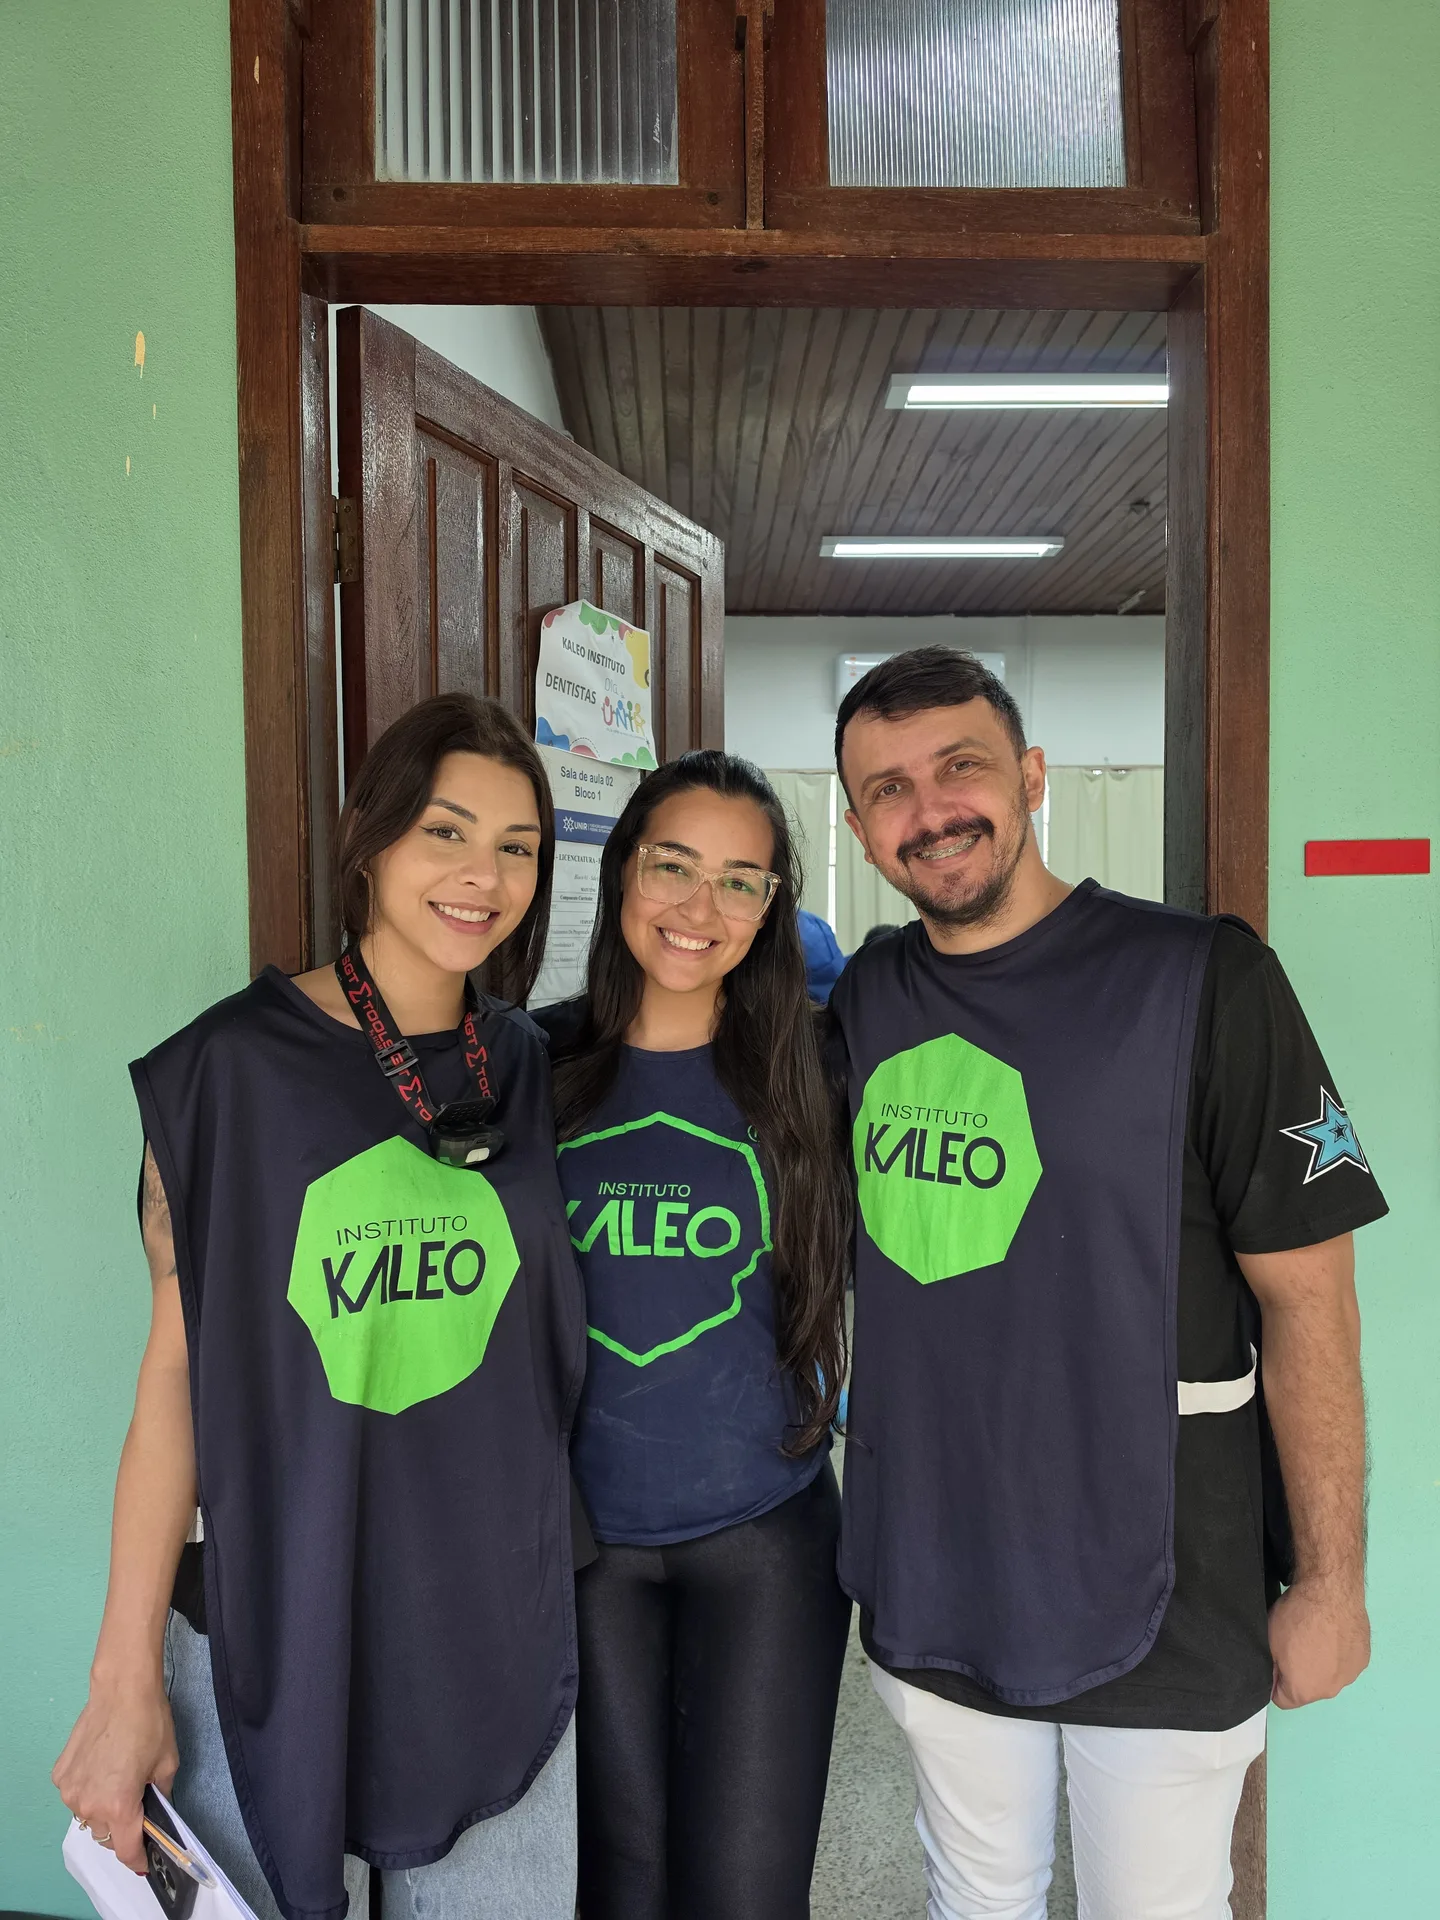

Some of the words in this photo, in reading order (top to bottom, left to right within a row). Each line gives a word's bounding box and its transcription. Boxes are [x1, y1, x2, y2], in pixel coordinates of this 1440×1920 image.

[562, 637, 586, 659] KALEO
[587, 649, 626, 676] INSTITUTO
[545, 672, 597, 705] DENTISTAS
[560, 766, 578, 780] Sala
[578, 770, 588, 782] de
[589, 773, 604, 785] aula
[605, 775, 614, 787] 02
[575, 786, 596, 800] Bloco
[597, 790, 602, 801] 1
[559, 854, 596, 864] LICENCIATURA
[341, 954, 359, 983] SGT
[464, 1012, 478, 1046] SGT
[881, 1103, 988, 1129] INSTITUTO
[864, 1122, 1007, 1189] KALEO
[598, 1182, 691, 1198] INSTITUTO
[336, 1215, 468, 1246] INSTITUTO
[321, 1239, 487, 1319] KALEO
